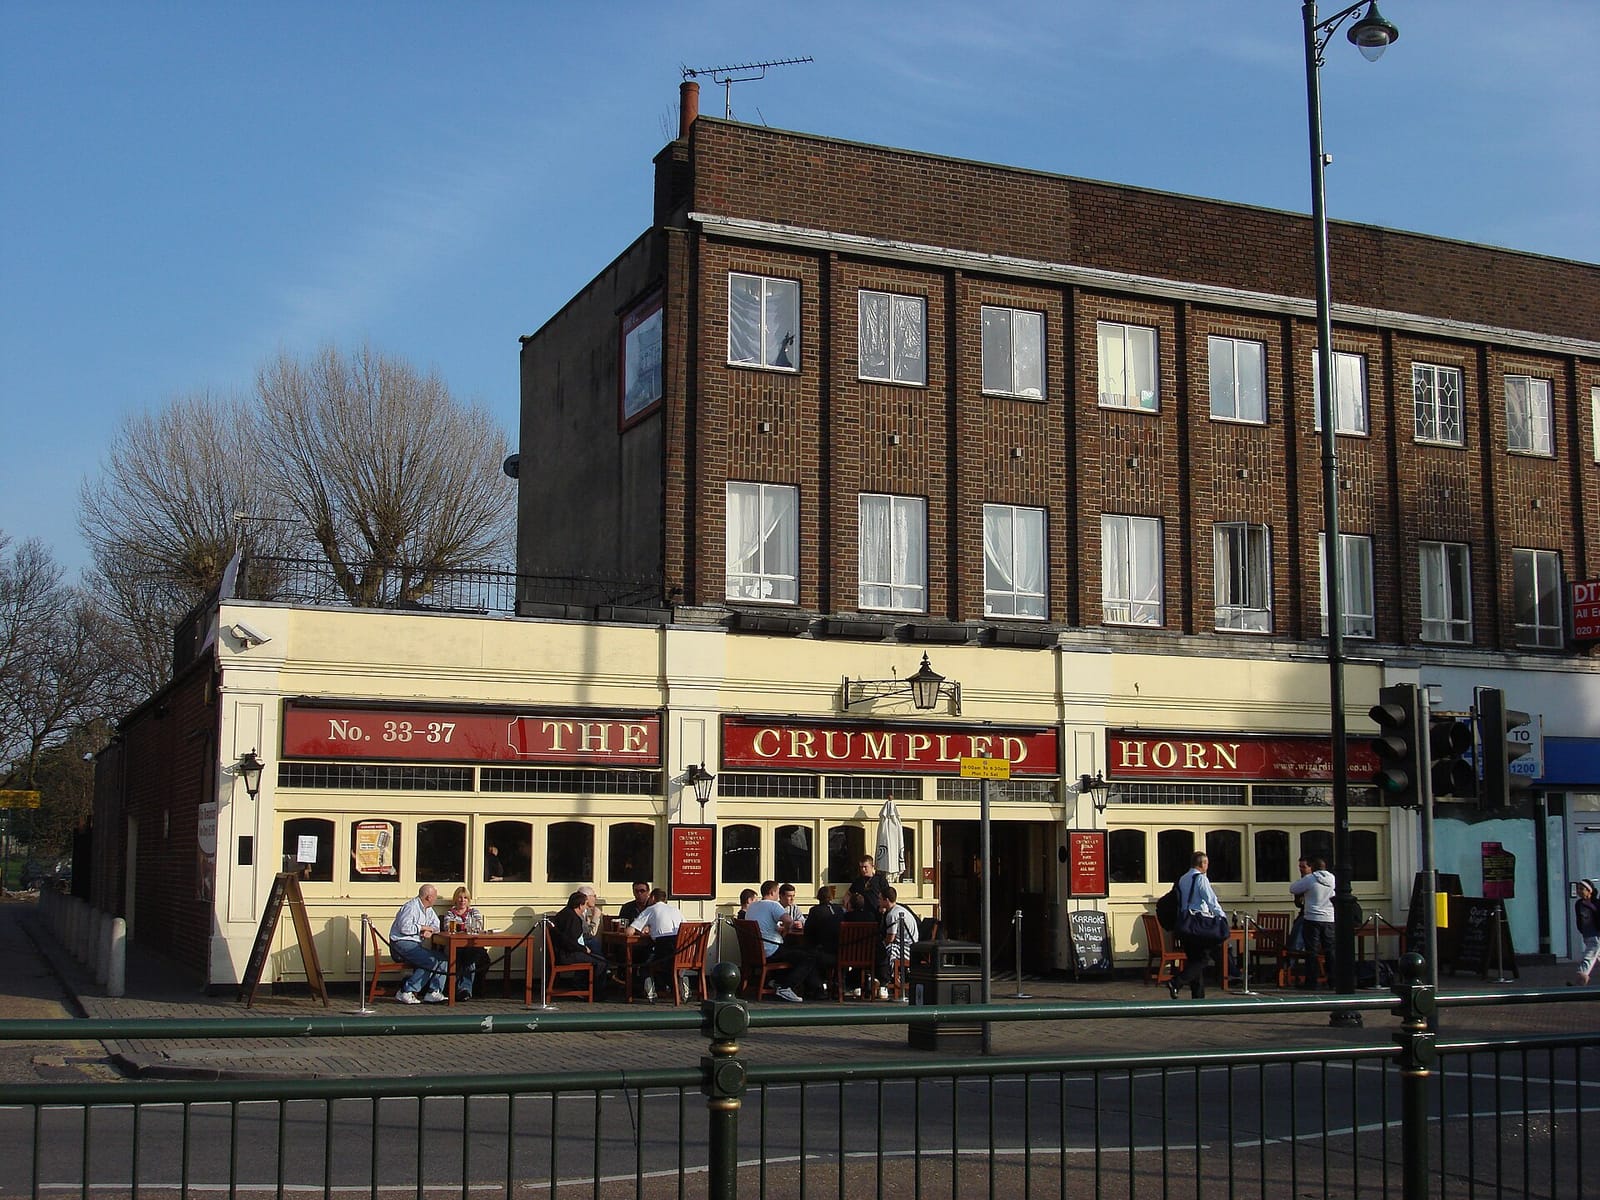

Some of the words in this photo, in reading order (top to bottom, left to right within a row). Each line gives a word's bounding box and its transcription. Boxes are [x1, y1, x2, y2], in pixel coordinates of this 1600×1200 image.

[1574, 583, 1600, 603] DT
[1576, 608, 1588, 618] All
[1576, 626, 1592, 635] 020
[328, 720, 371, 741] No.
[382, 721, 456, 743] 33-37
[542, 721, 649, 753] THE
[1513, 730, 1530, 741] TO
[752, 728, 1029, 764] CRUMPLED
[1118, 740, 1241, 769] HORN
[1071, 914, 1105, 925] KARAOKE
